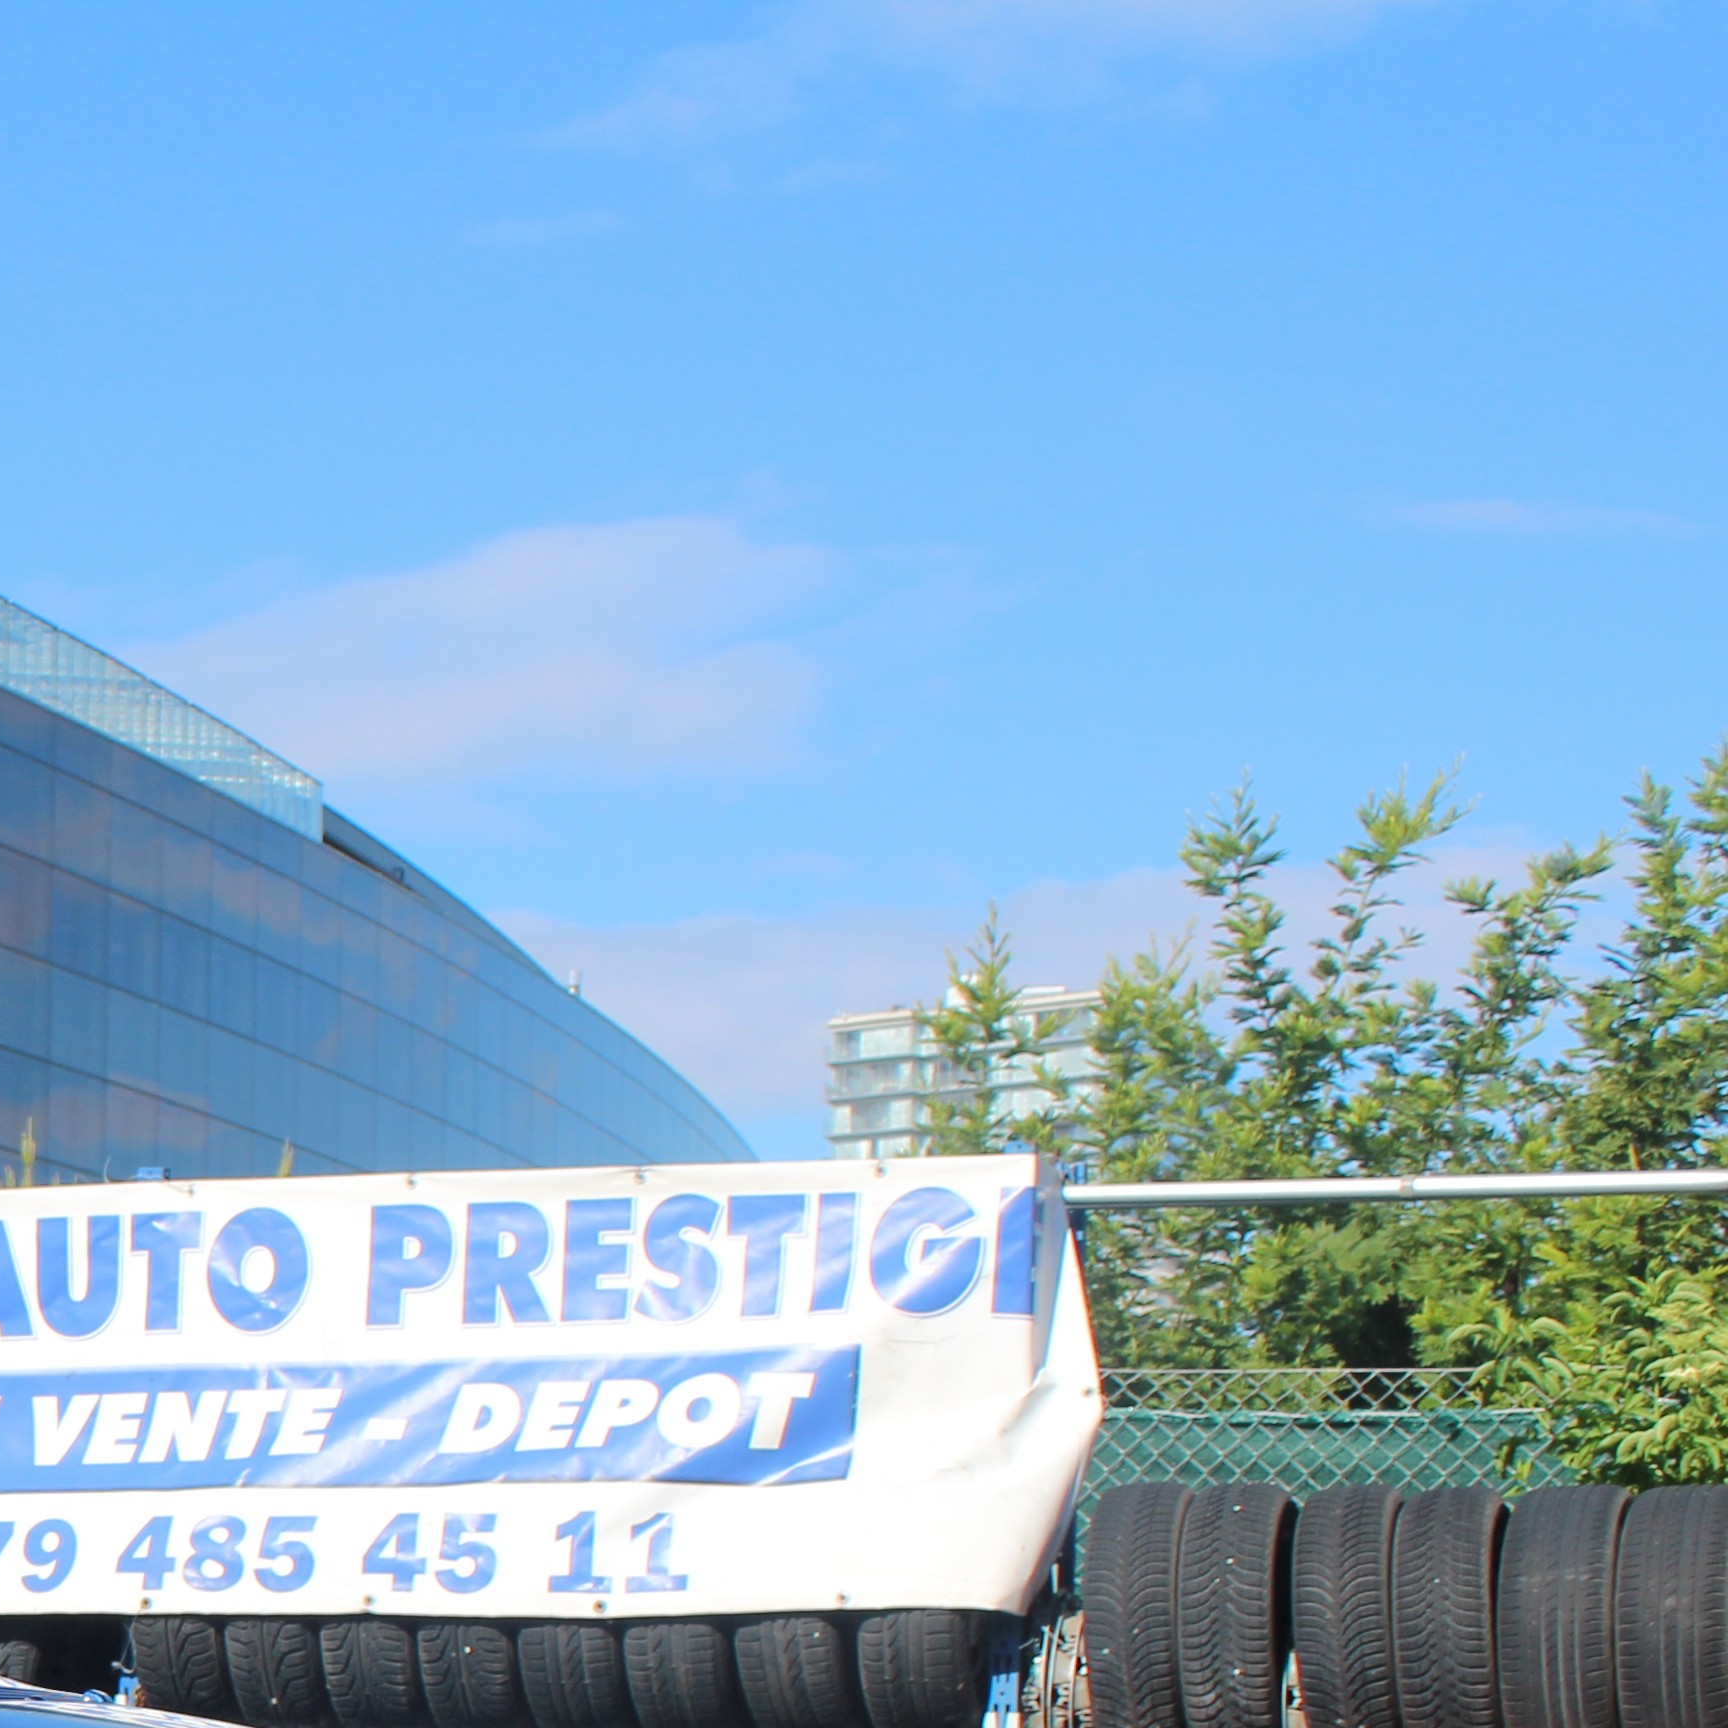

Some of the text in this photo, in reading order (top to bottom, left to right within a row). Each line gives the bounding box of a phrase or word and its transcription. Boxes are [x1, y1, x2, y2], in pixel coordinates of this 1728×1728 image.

[31, 1388, 343, 1467] VENTE
[437, 1372, 815, 1454] DEPOT
[117, 1515, 317, 1592] 485
[362, 1513, 498, 1594] 45
[548, 1511, 689, 1594] 11
